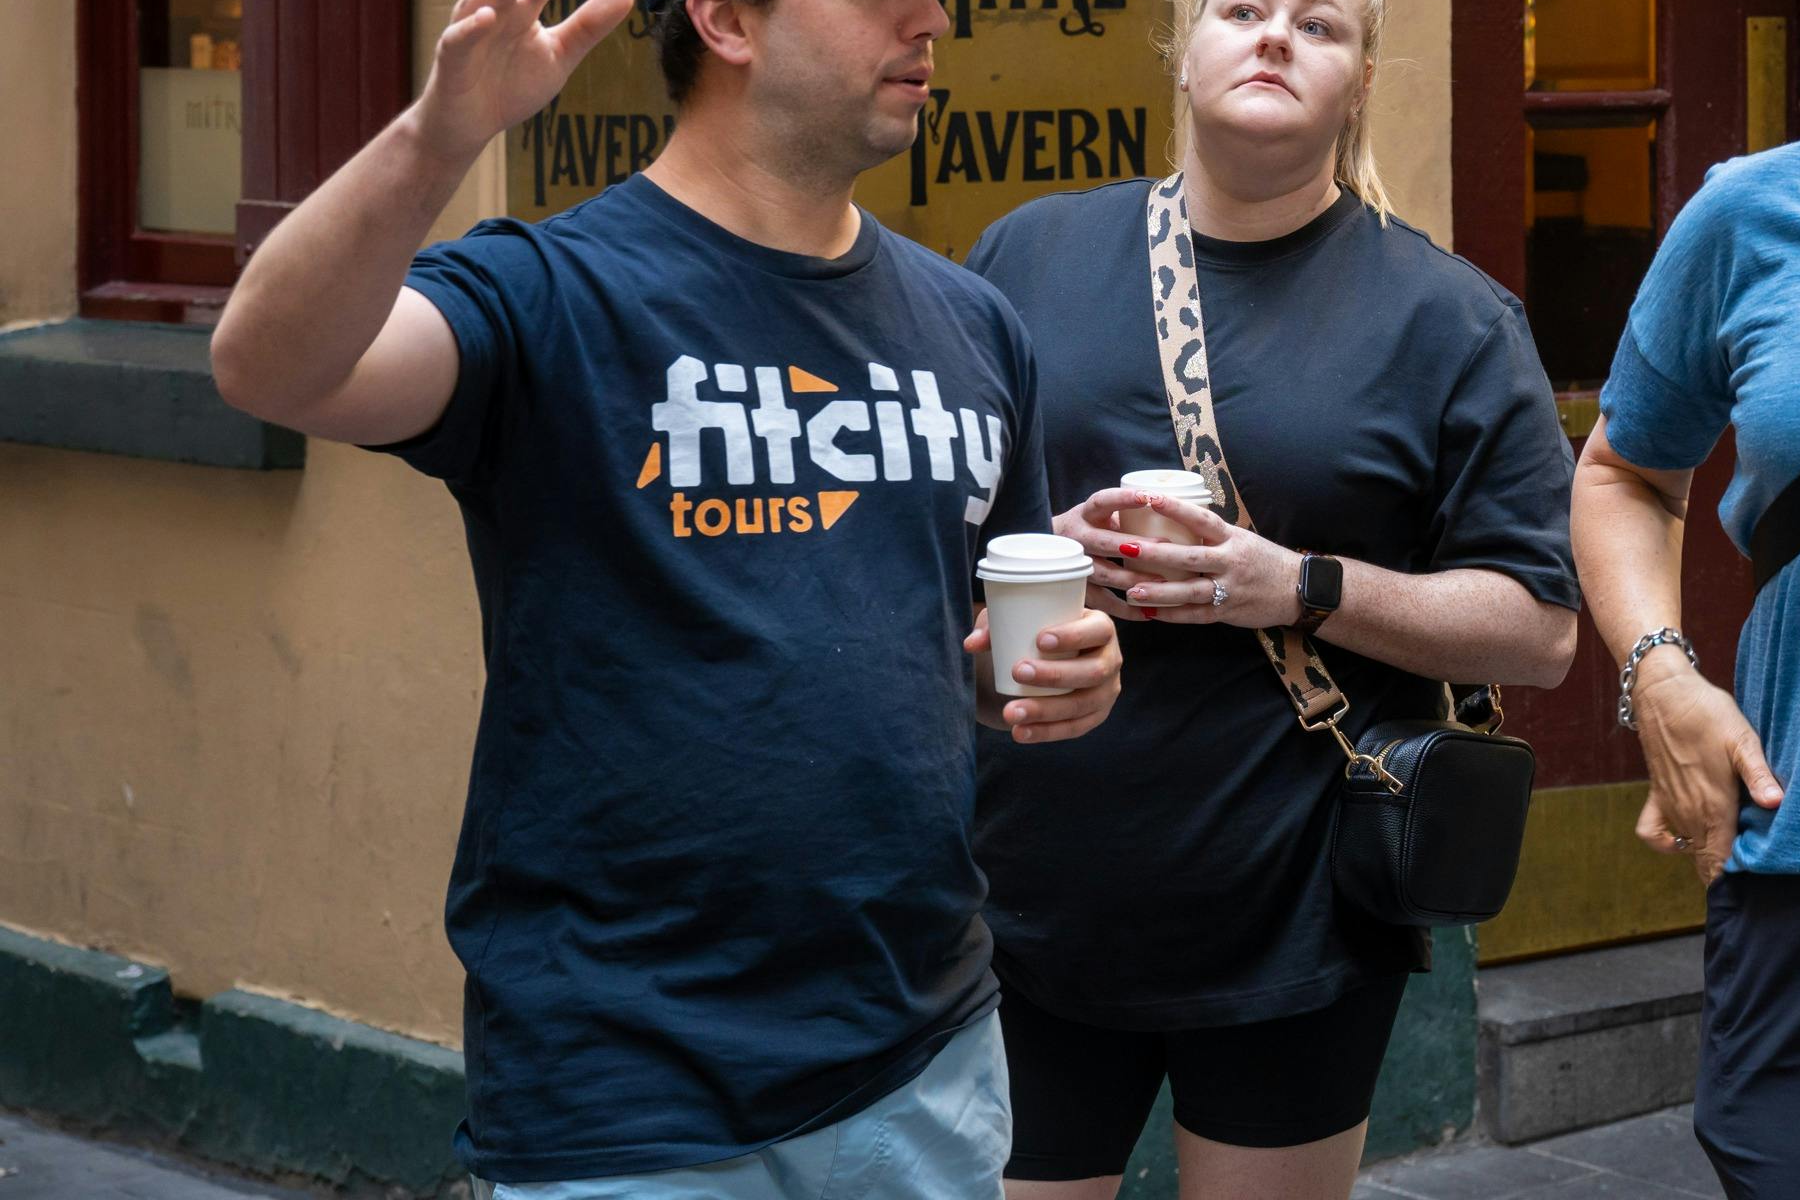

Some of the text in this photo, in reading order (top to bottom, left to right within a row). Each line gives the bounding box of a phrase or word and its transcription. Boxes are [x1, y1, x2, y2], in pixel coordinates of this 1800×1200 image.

[911, 89, 1147, 206] TAVERN
[652, 354, 1001, 525] fitcity
[670, 492, 813, 537] tours
